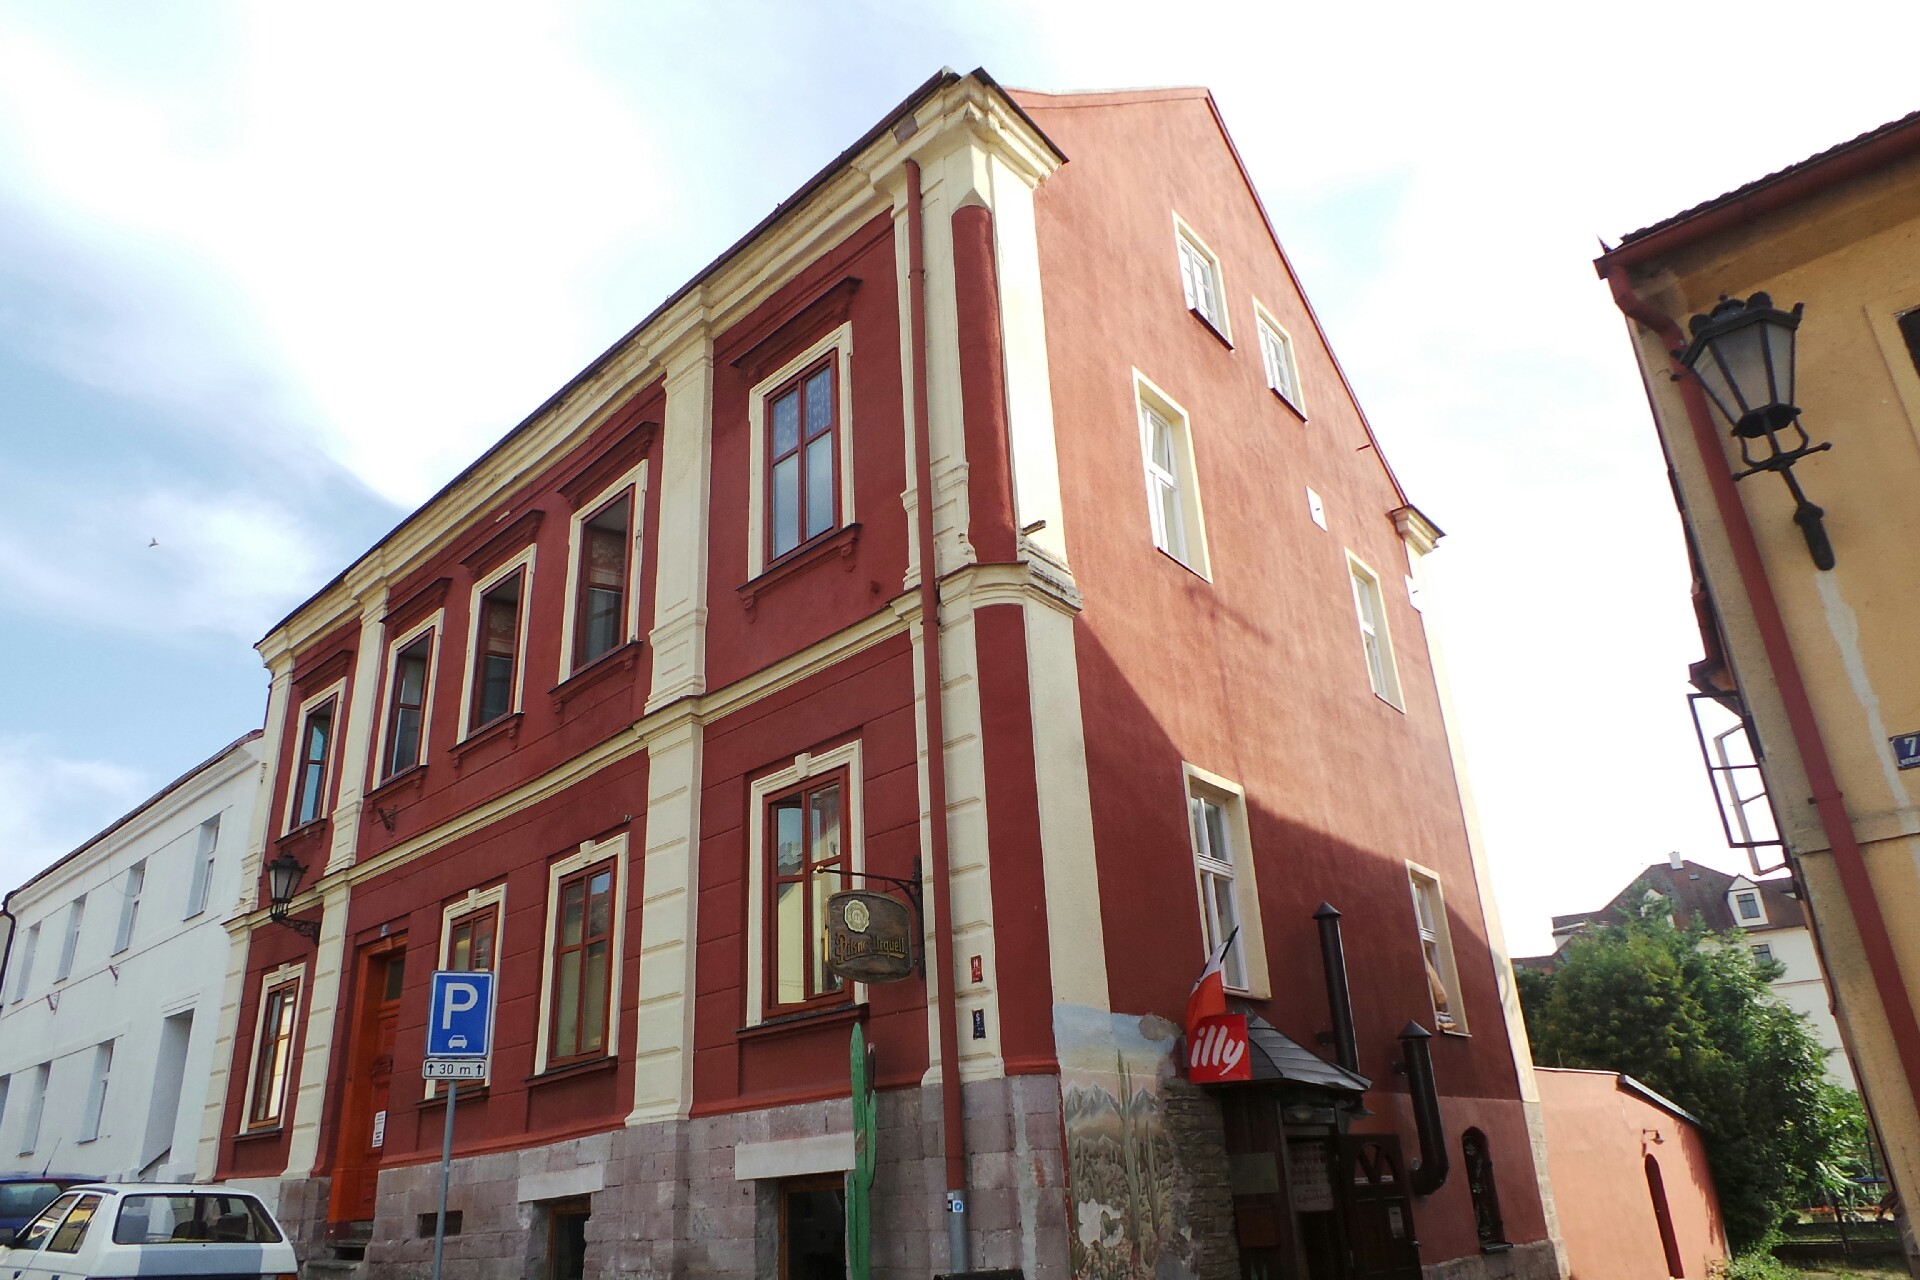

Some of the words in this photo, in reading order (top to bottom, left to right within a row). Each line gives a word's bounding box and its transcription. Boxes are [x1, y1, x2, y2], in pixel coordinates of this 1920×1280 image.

[1904, 736, 1917, 756] 7
[442, 982, 479, 1030] P
[1191, 1024, 1246, 1076] illy
[439, 1064, 454, 1075] 30
[459, 1067, 471, 1075] m
